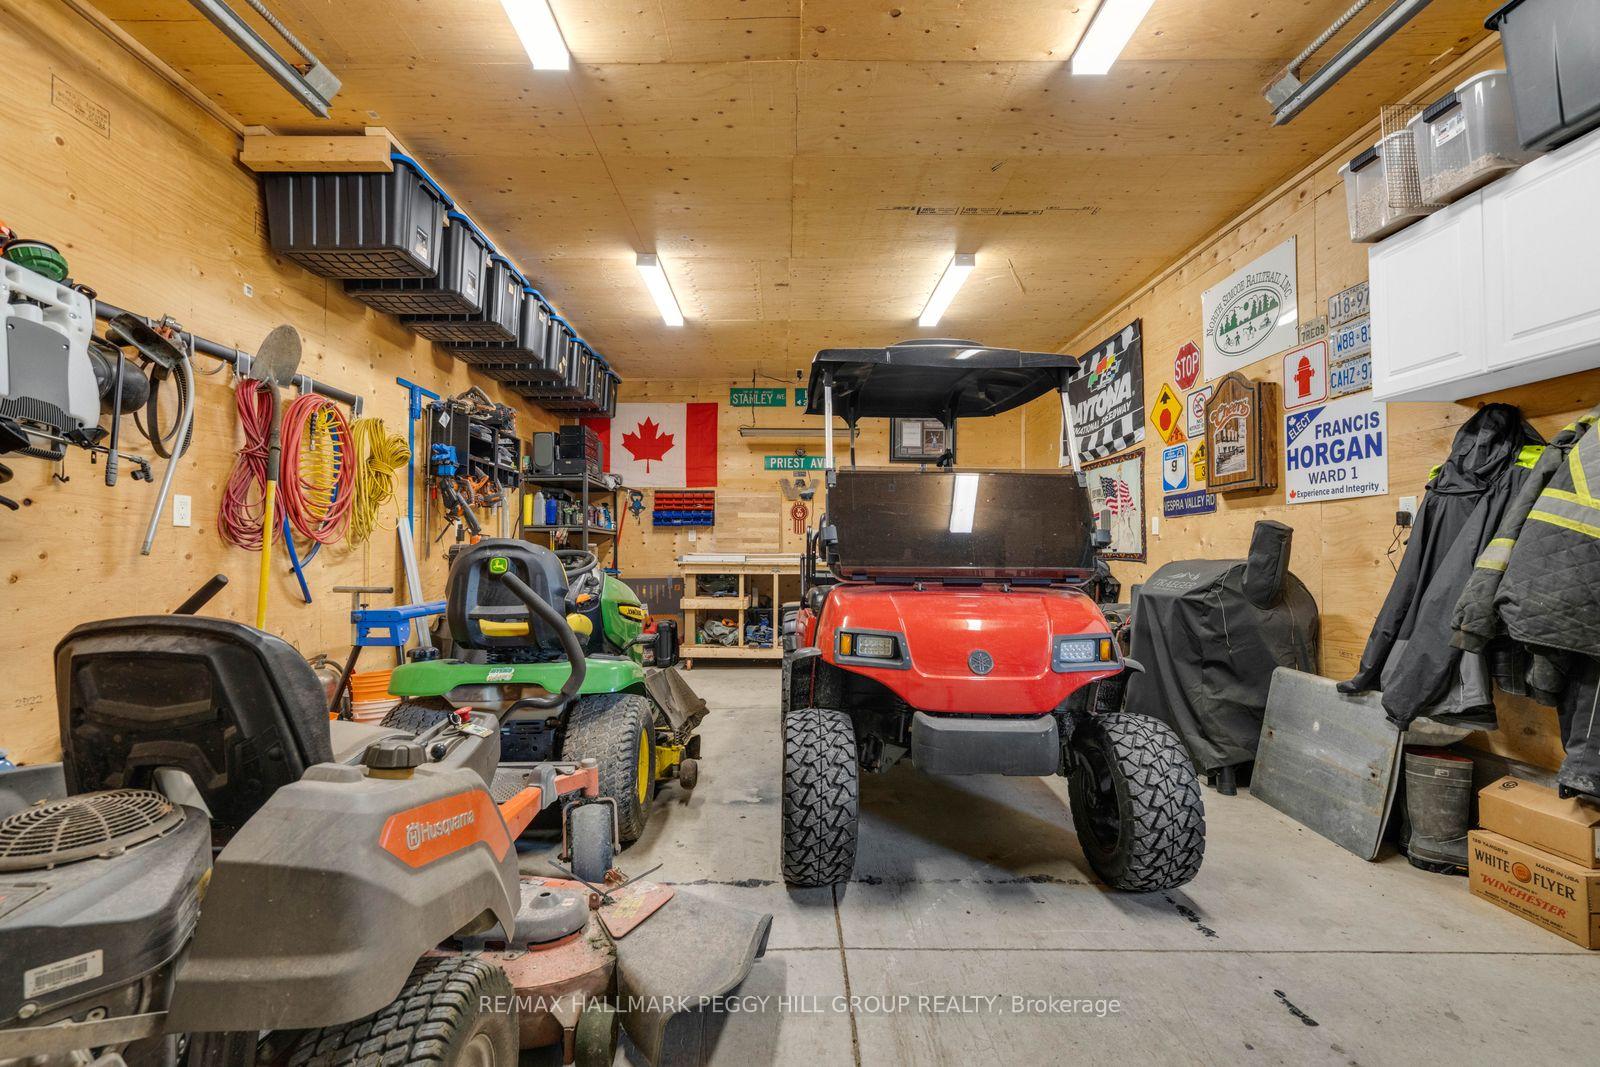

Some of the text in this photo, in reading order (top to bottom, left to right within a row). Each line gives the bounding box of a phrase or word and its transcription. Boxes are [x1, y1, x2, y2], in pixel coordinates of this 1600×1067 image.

[1206, 302, 1224, 337] NORTH
[1222, 280, 1246, 306] SIMCOE
[1175, 352, 1199, 381] STOP
[1330, 367, 1355, 389] CAHZ
[732, 393, 773, 405] STANLEY
[1074, 401, 1132, 436] NATIONAL SPEEDWAY
[1288, 413, 1312, 440] ELECT
[1315, 411, 1380, 440] FRANCIS
[770, 458, 806, 468] PRIEST
[1287, 431, 1383, 471] HORGAN
[1308, 466, 1358, 485] WARD 1
[1184, 494, 1204, 509] VALLEY
[1205, 494, 1215, 506] RD
[1297, 482, 1380, 499] Experience and Integrity
[420, 810, 475, 843] Husqvarna
[1483, 841, 1509, 855] TARGETS
[1474, 848, 1510, 873] WHITE
[1533, 872, 1577, 902] FLYER
[1535, 863, 1555, 874] MADE
[1564, 874, 1580, 884] USA
[1481, 873, 1567, 919] WINCHESTER
